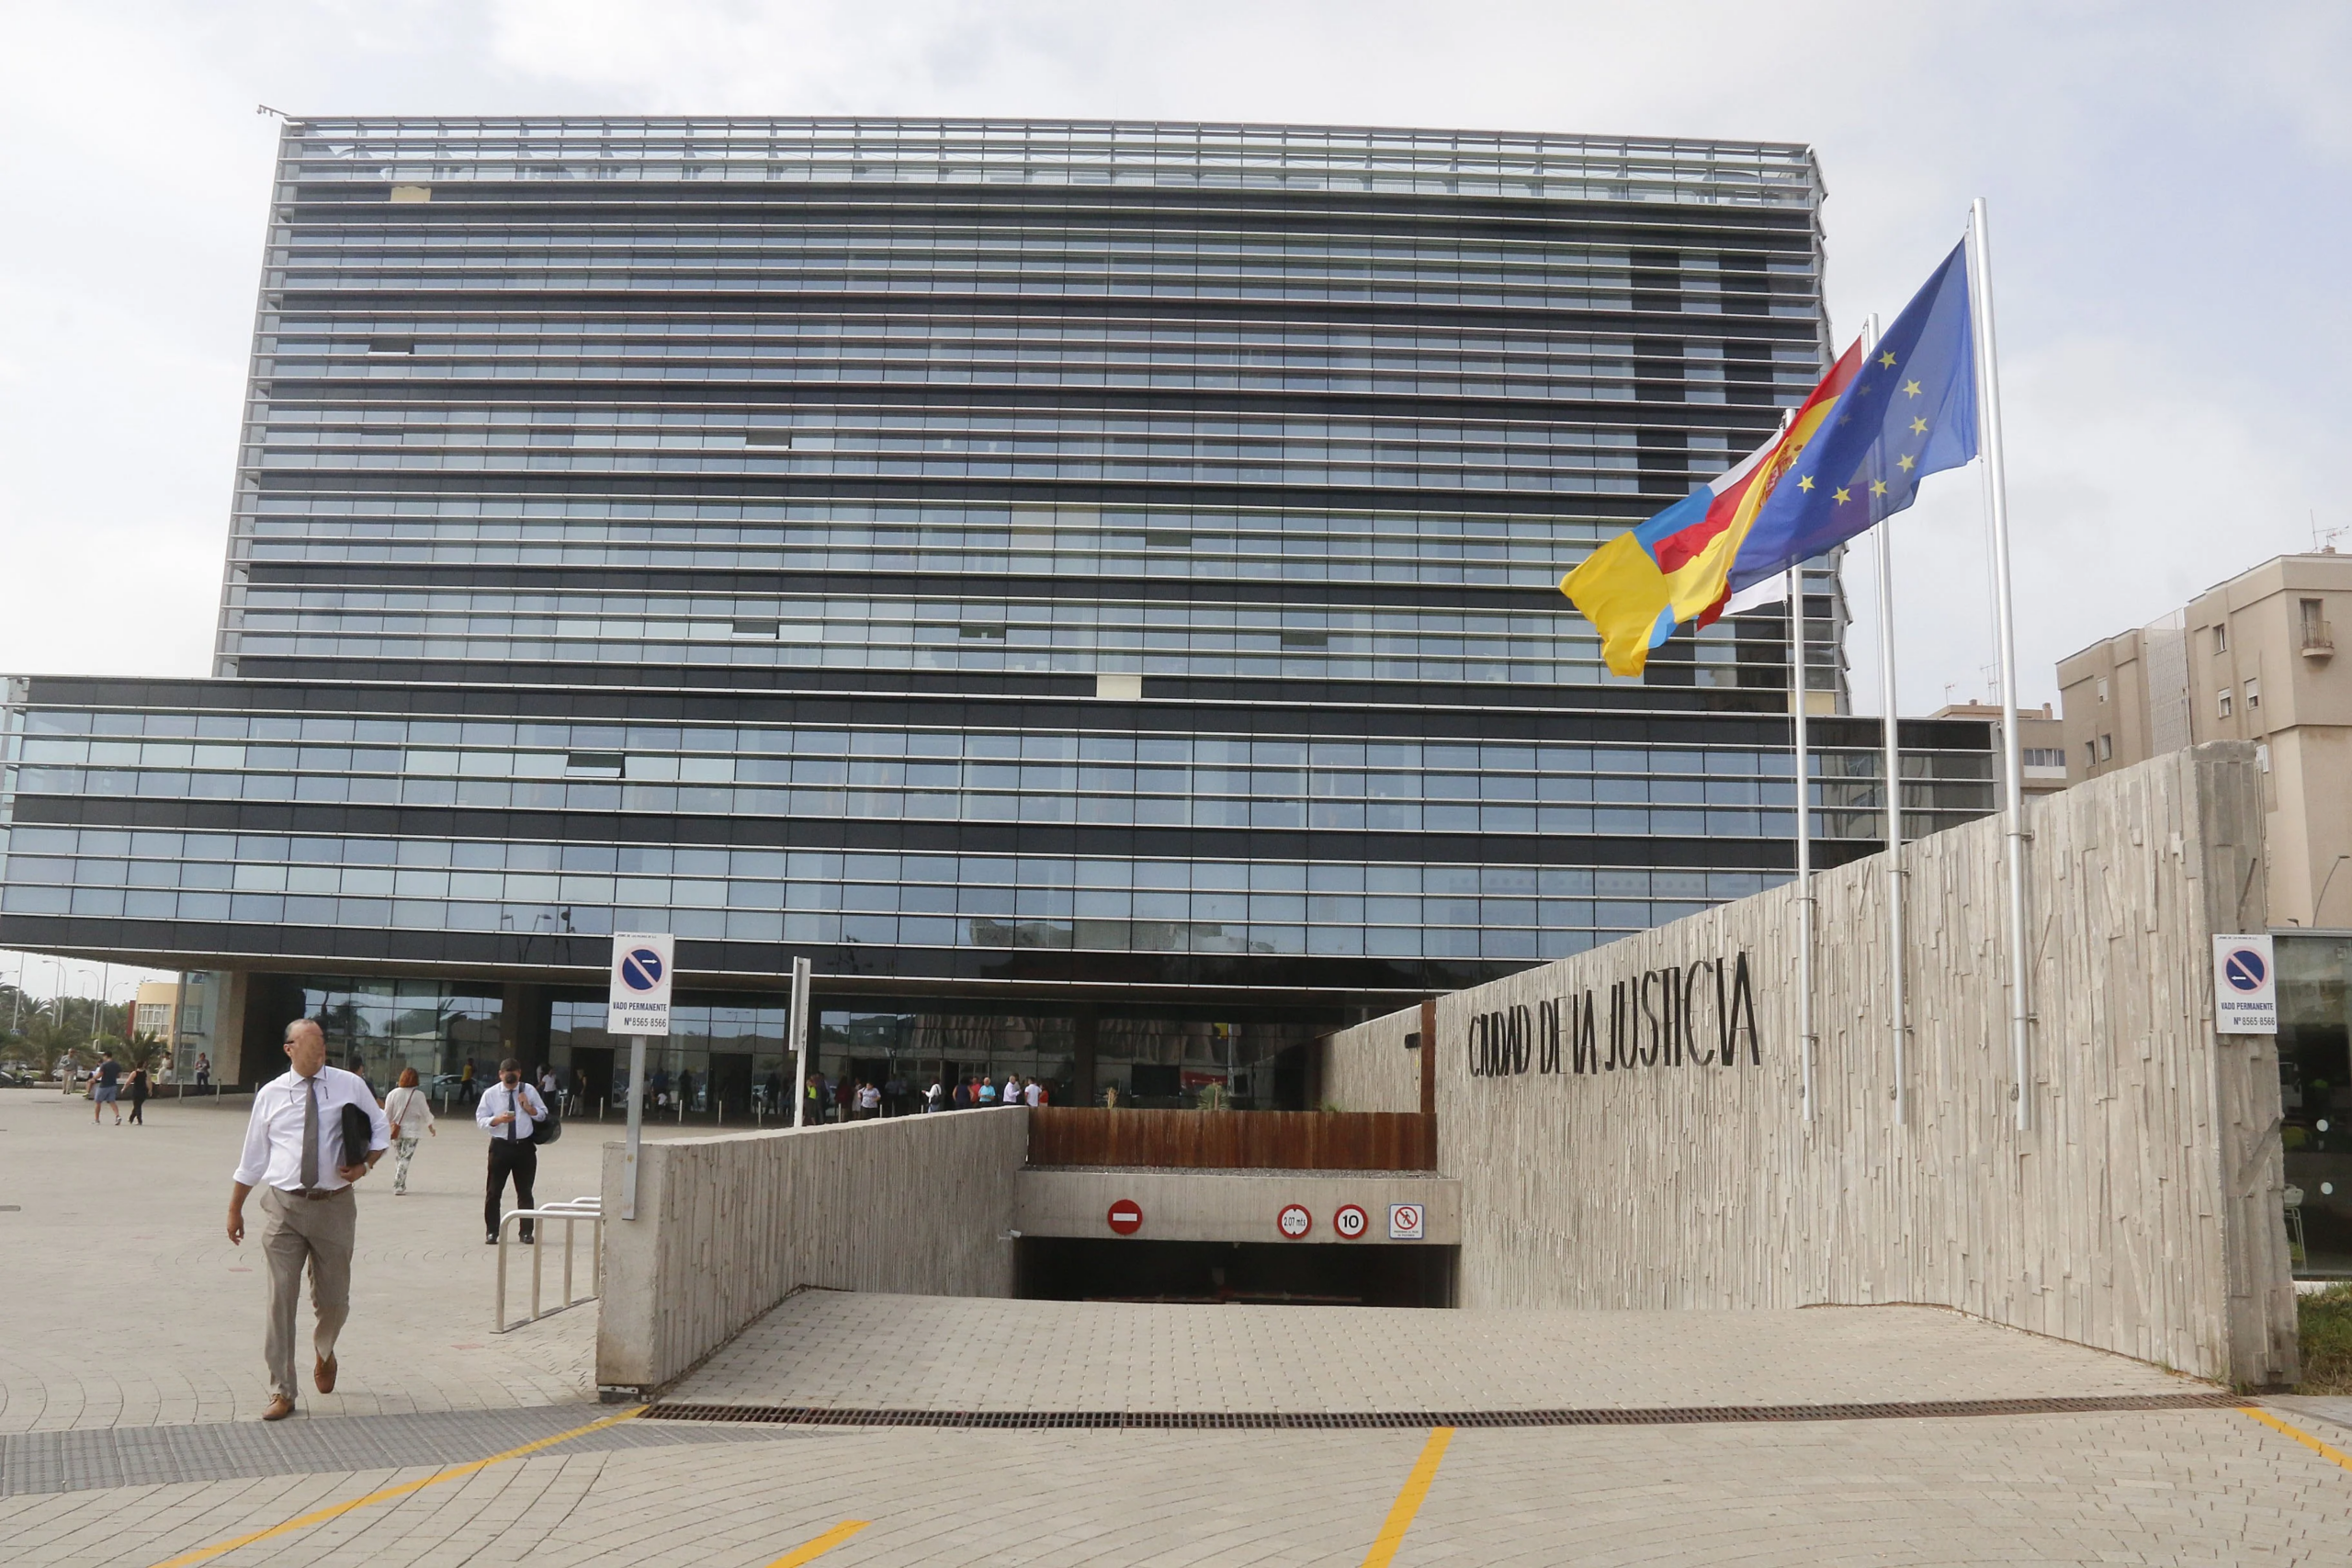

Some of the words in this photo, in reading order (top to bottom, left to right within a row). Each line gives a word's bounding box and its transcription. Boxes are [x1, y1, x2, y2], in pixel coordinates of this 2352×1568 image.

[613, 1001, 628, 1010] VADO
[628, 1002, 667, 1012] PERMANENTE
[2221, 1002, 2235, 1010] VADO
[2236, 1002, 2274, 1010] PERMANENTE
[1469, 1004, 1532, 1077] CIUDAD
[1539, 996, 1566, 1075] DE
[1604, 951, 1760, 1072] JUSTICIA
[1342, 1214, 1360, 1228] 10
